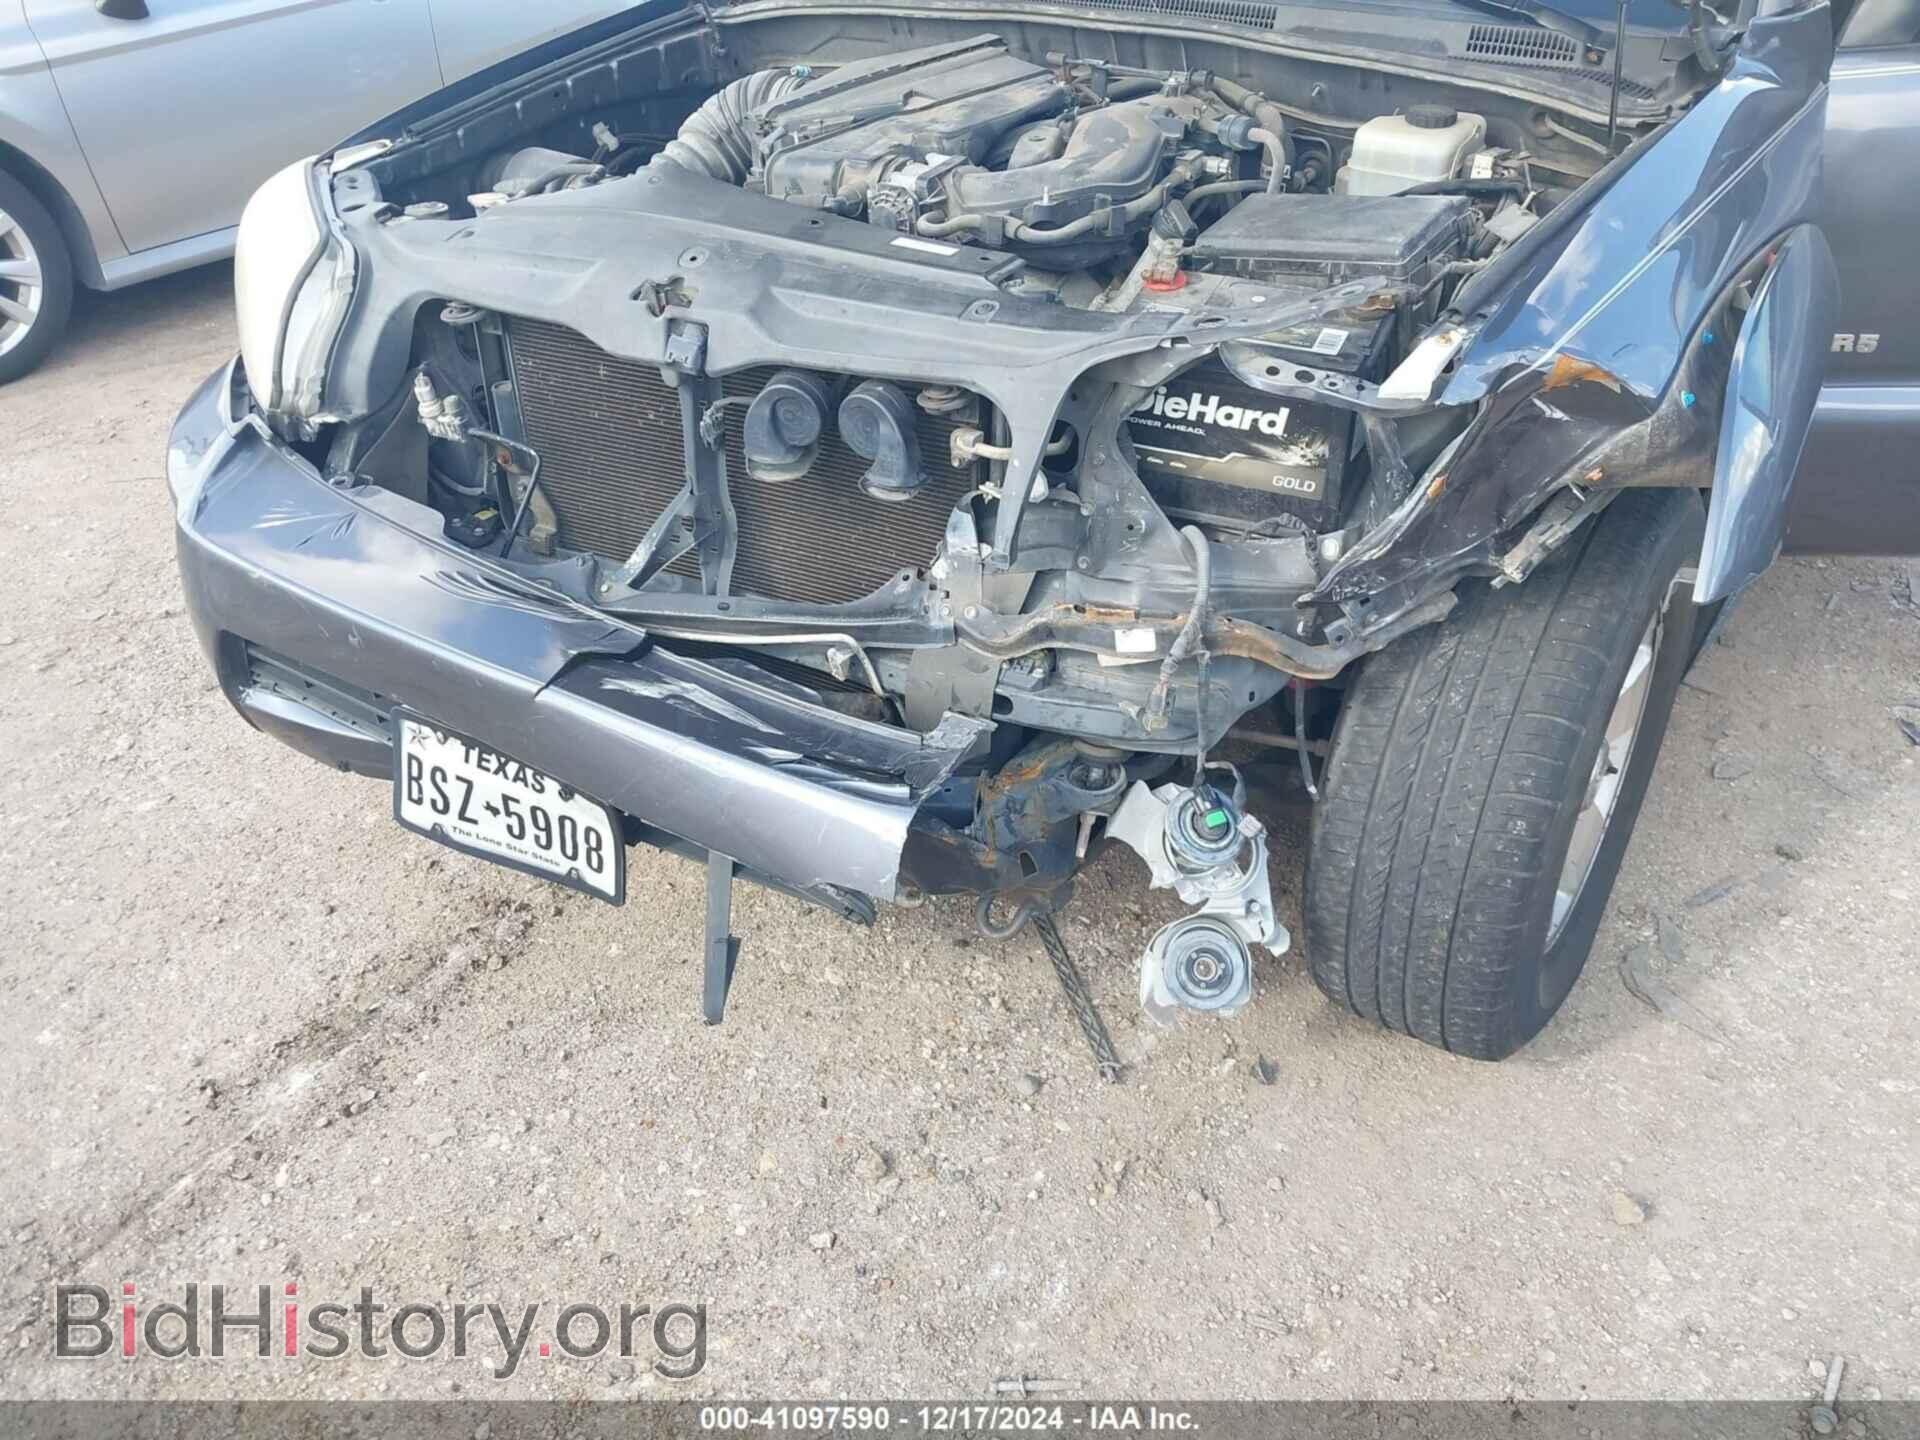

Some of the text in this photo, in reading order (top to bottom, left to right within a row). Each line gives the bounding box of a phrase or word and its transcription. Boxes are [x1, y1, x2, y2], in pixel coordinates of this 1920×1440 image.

[1830, 333, 1880, 353] R5
[1272, 474, 1316, 492] GOLD
[463, 745, 546, 794] TEXAS
[452, 825, 561, 866] The Lone Star State
